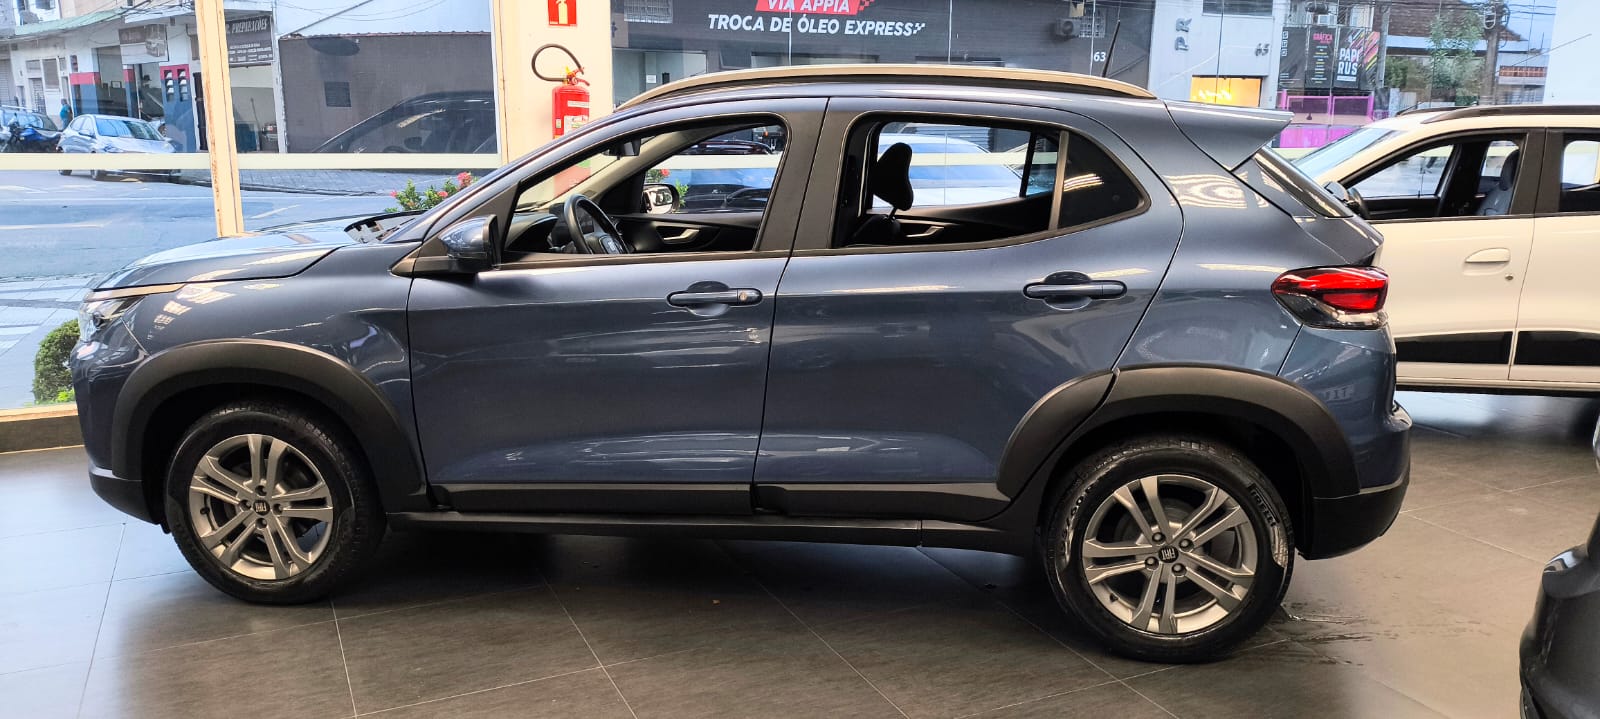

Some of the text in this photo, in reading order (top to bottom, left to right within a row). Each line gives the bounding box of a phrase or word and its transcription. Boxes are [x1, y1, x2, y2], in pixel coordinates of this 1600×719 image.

[768, 0, 849, 12] VIA APPIA
[708, 14, 914, 36] TROCA DE ÓLEO EXPRESS
[1093, 51, 1106, 62] 63
[1337, 61, 1358, 75] RUS
[1161, 548, 1176, 560] FIAT
